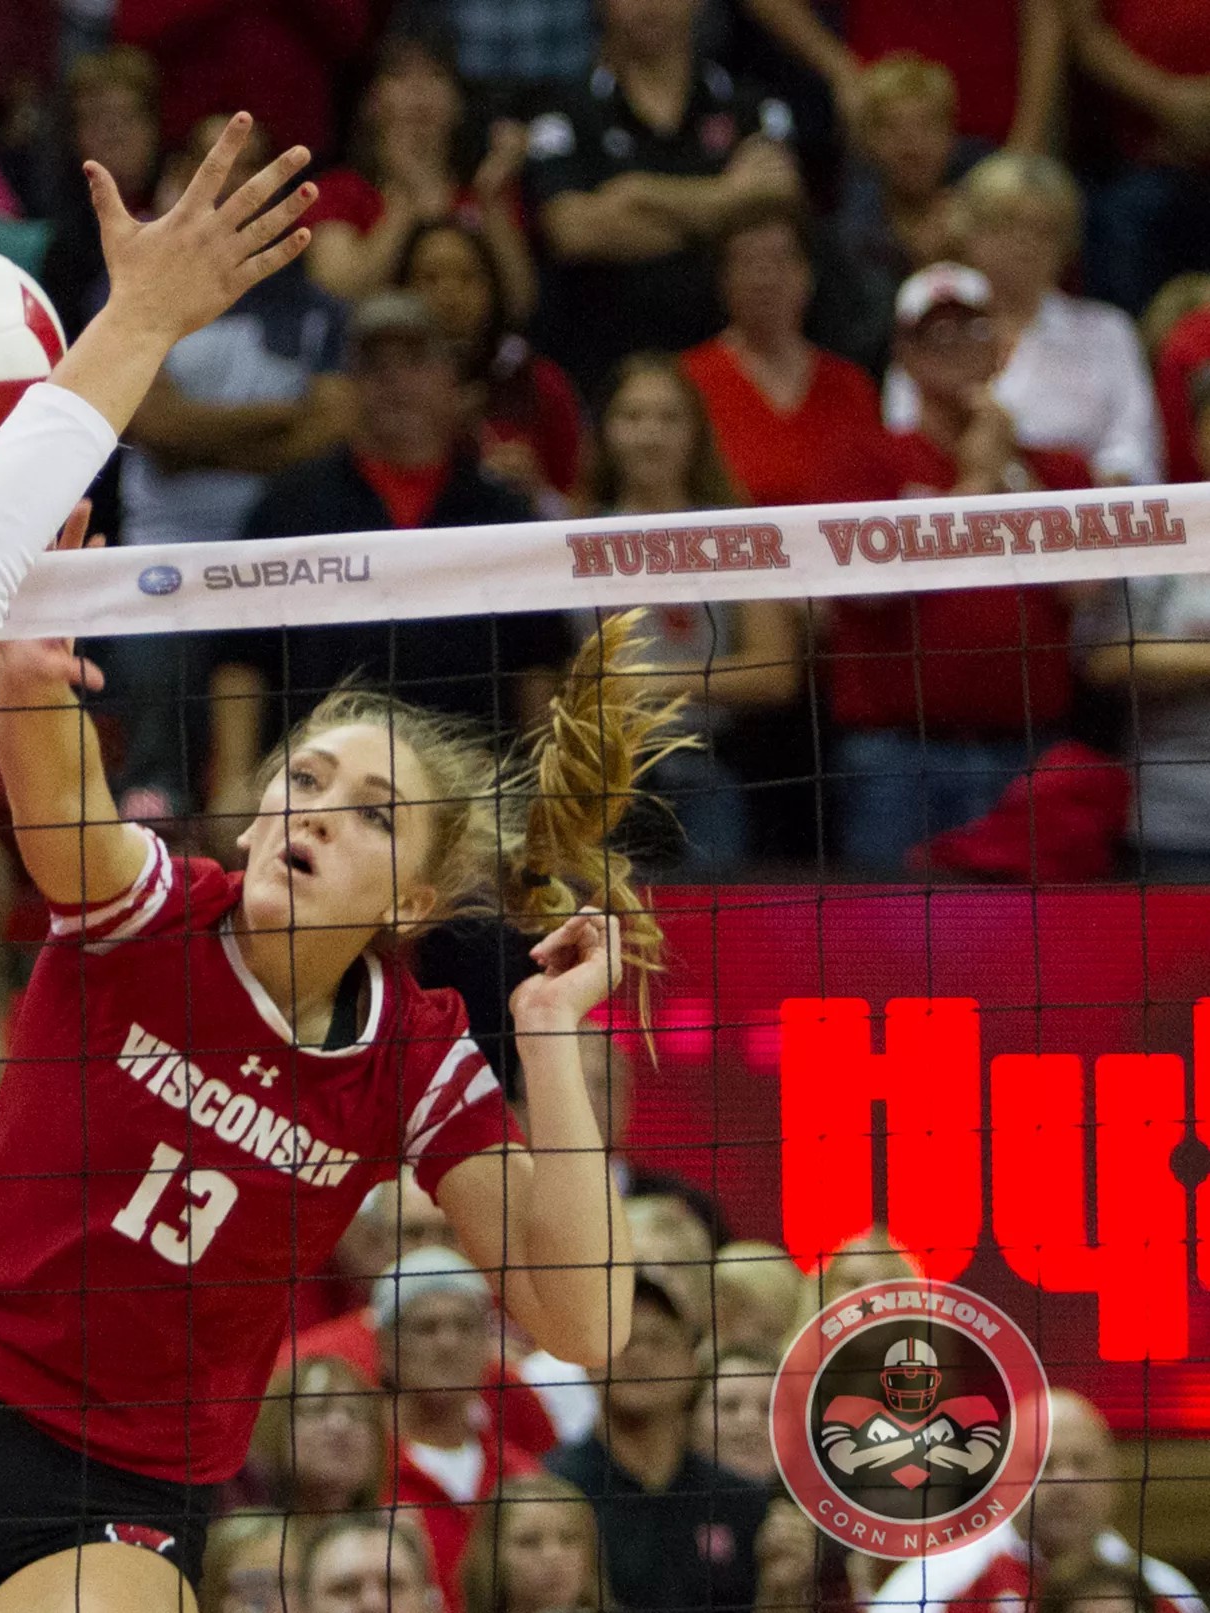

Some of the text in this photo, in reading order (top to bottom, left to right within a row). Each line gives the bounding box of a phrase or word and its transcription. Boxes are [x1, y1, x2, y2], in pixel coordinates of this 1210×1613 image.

[203, 555, 371, 590] SUBARU
[566, 499, 1186, 578] HUSKER VOLLEYBALL
[116, 1021, 360, 1188] WISCONSIN
[111, 1141, 239, 1266] 13
